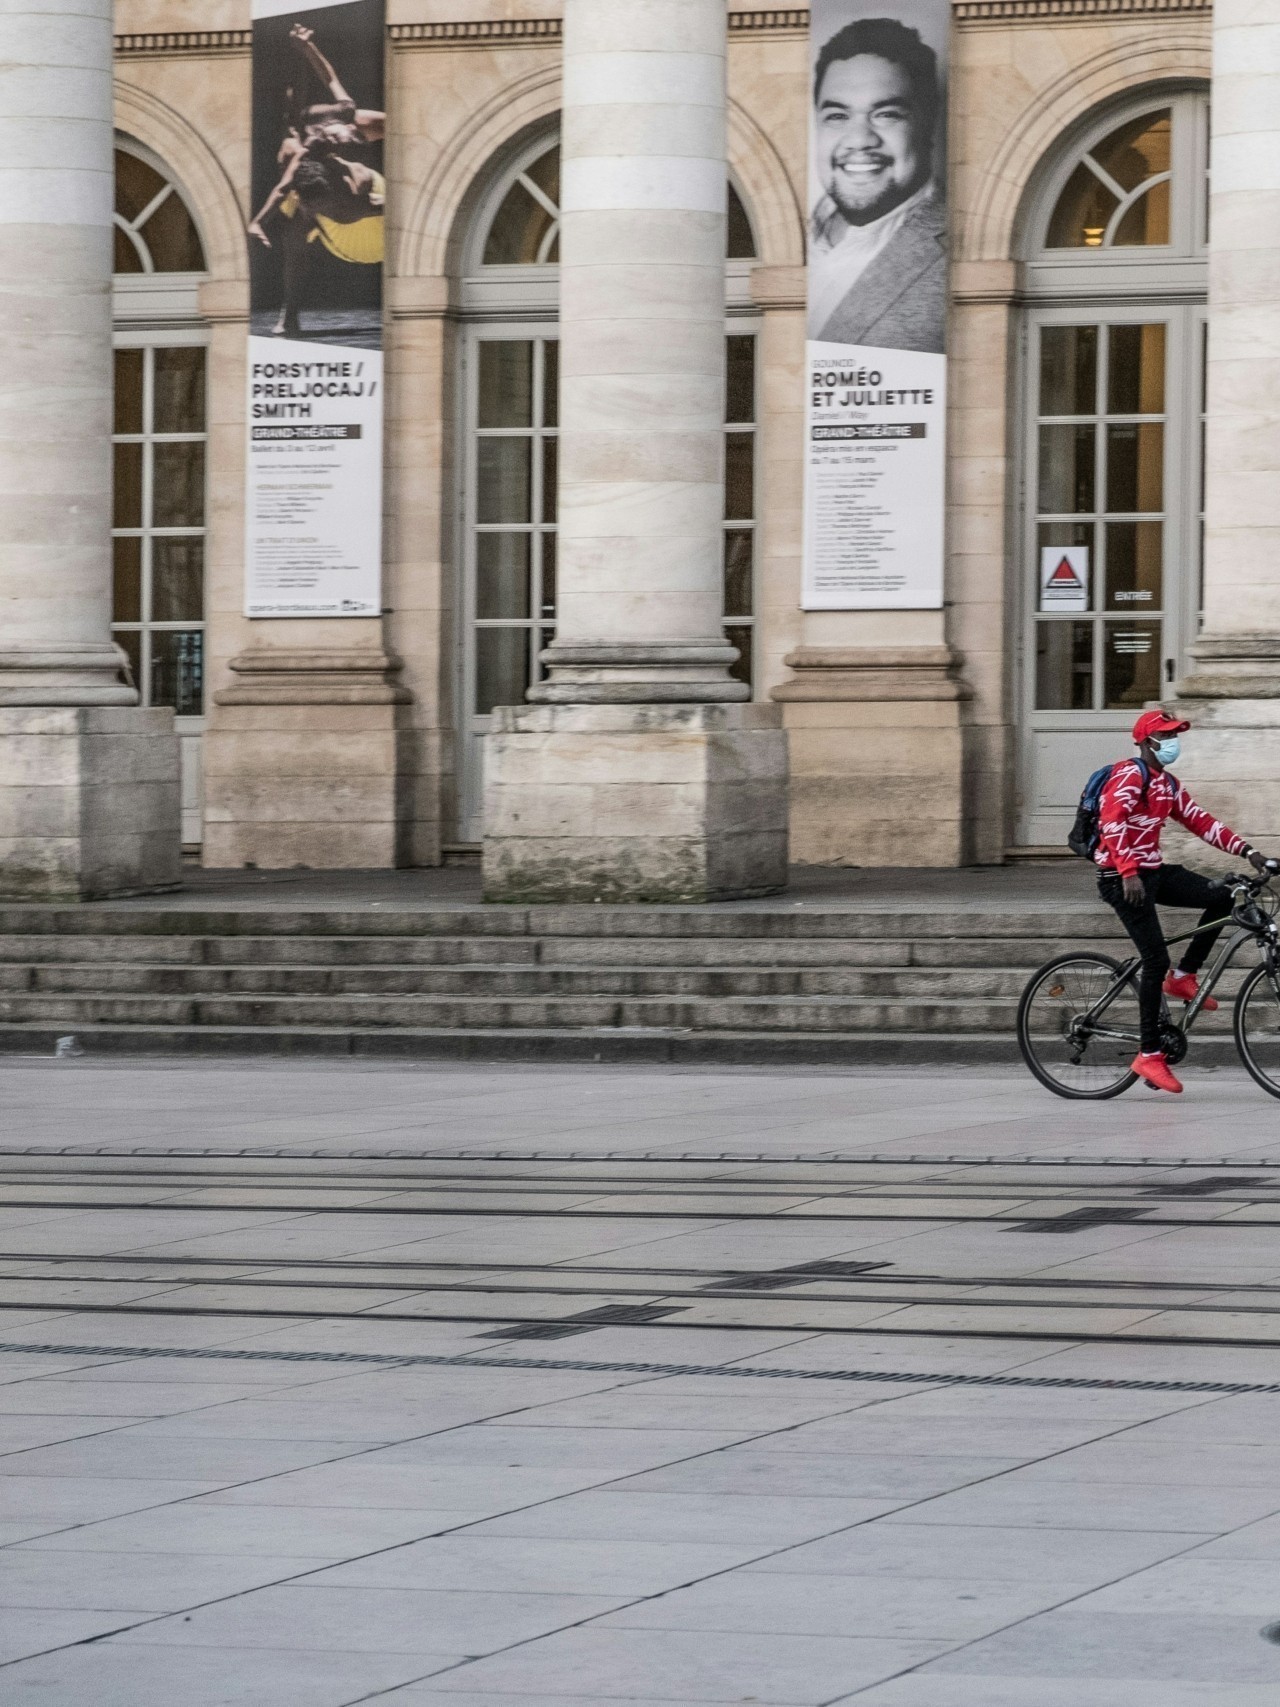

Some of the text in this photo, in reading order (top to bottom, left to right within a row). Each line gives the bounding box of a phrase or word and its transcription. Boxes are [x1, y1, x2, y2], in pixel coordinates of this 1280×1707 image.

[253, 362, 351, 379] FORSYTHE
[812, 366, 882, 388] ROMÉO
[253, 382, 363, 398] PRELJOCAJ
[812, 389, 934, 407] ET JULIETTE
[252, 402, 312, 418] SMITH
[252, 424, 348, 440] GRAND-THÉÂTRE
[812, 423, 912, 440] GRAND-THÉÂTRE
